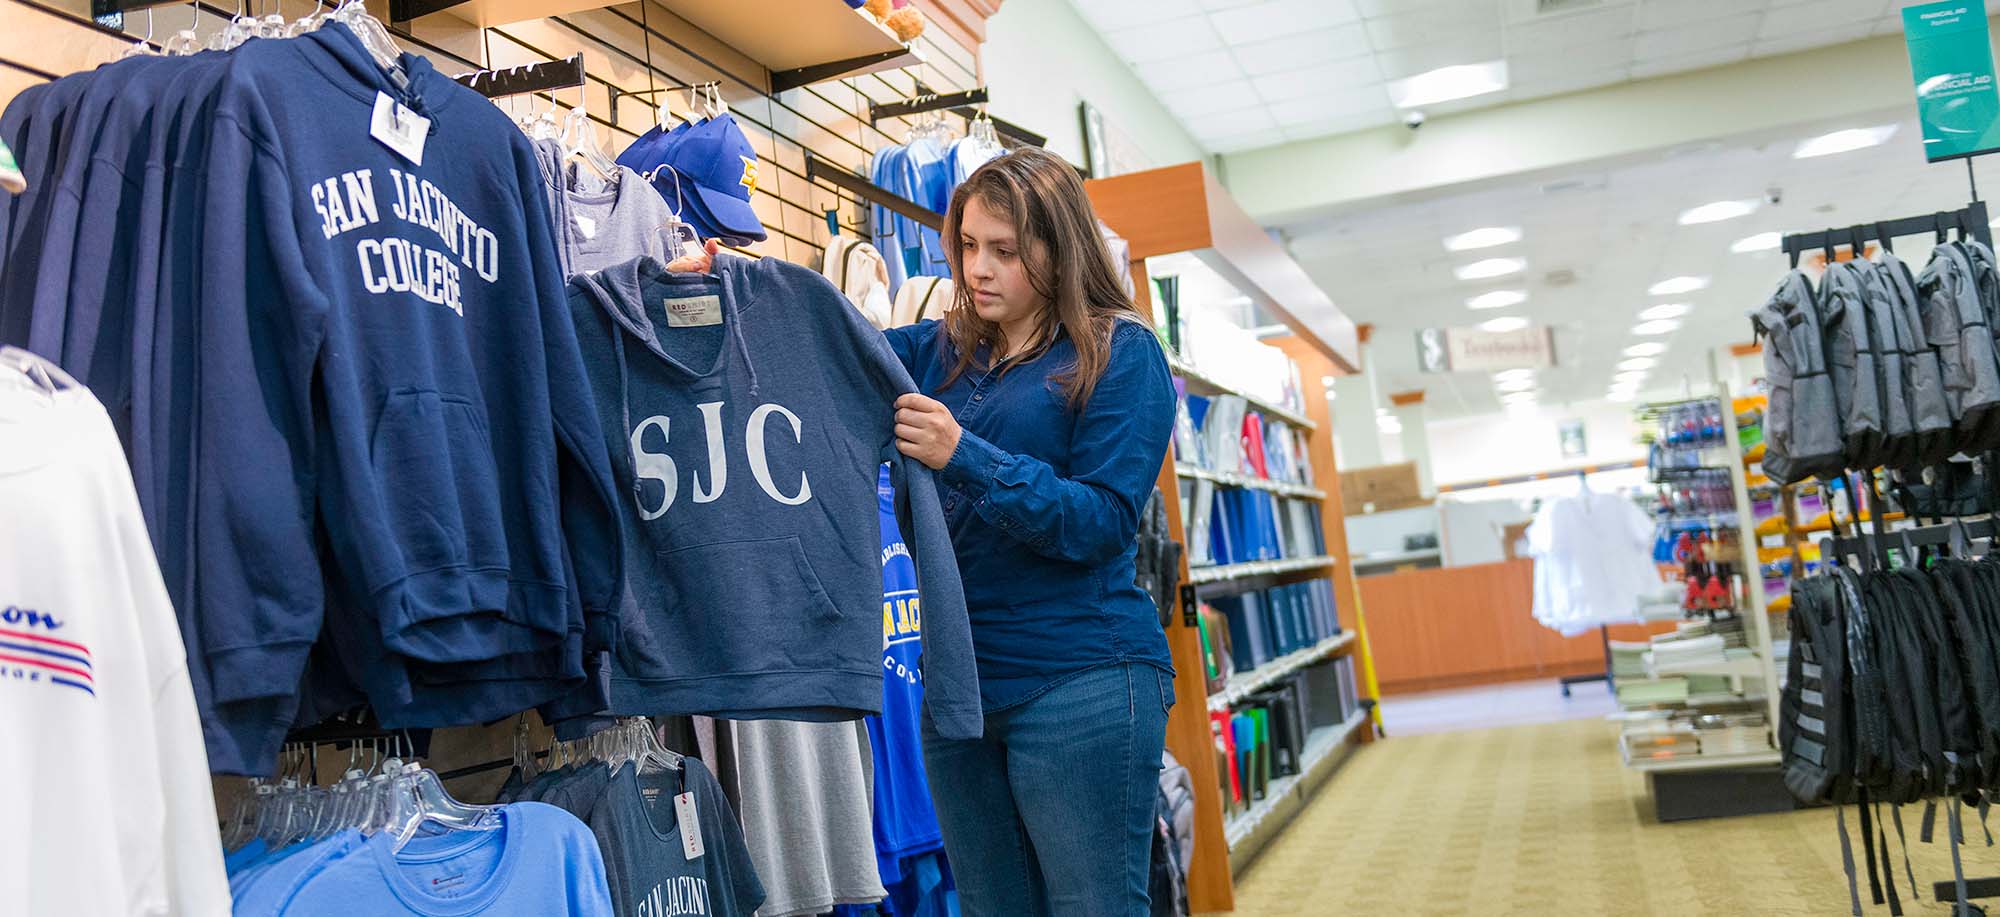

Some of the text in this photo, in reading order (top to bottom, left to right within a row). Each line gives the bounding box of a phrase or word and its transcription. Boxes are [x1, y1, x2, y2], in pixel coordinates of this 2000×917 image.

[311, 168, 499, 284] SAN JACINTO
[356, 237, 464, 318] COLLEGE
[630, 401, 812, 521] SJC
